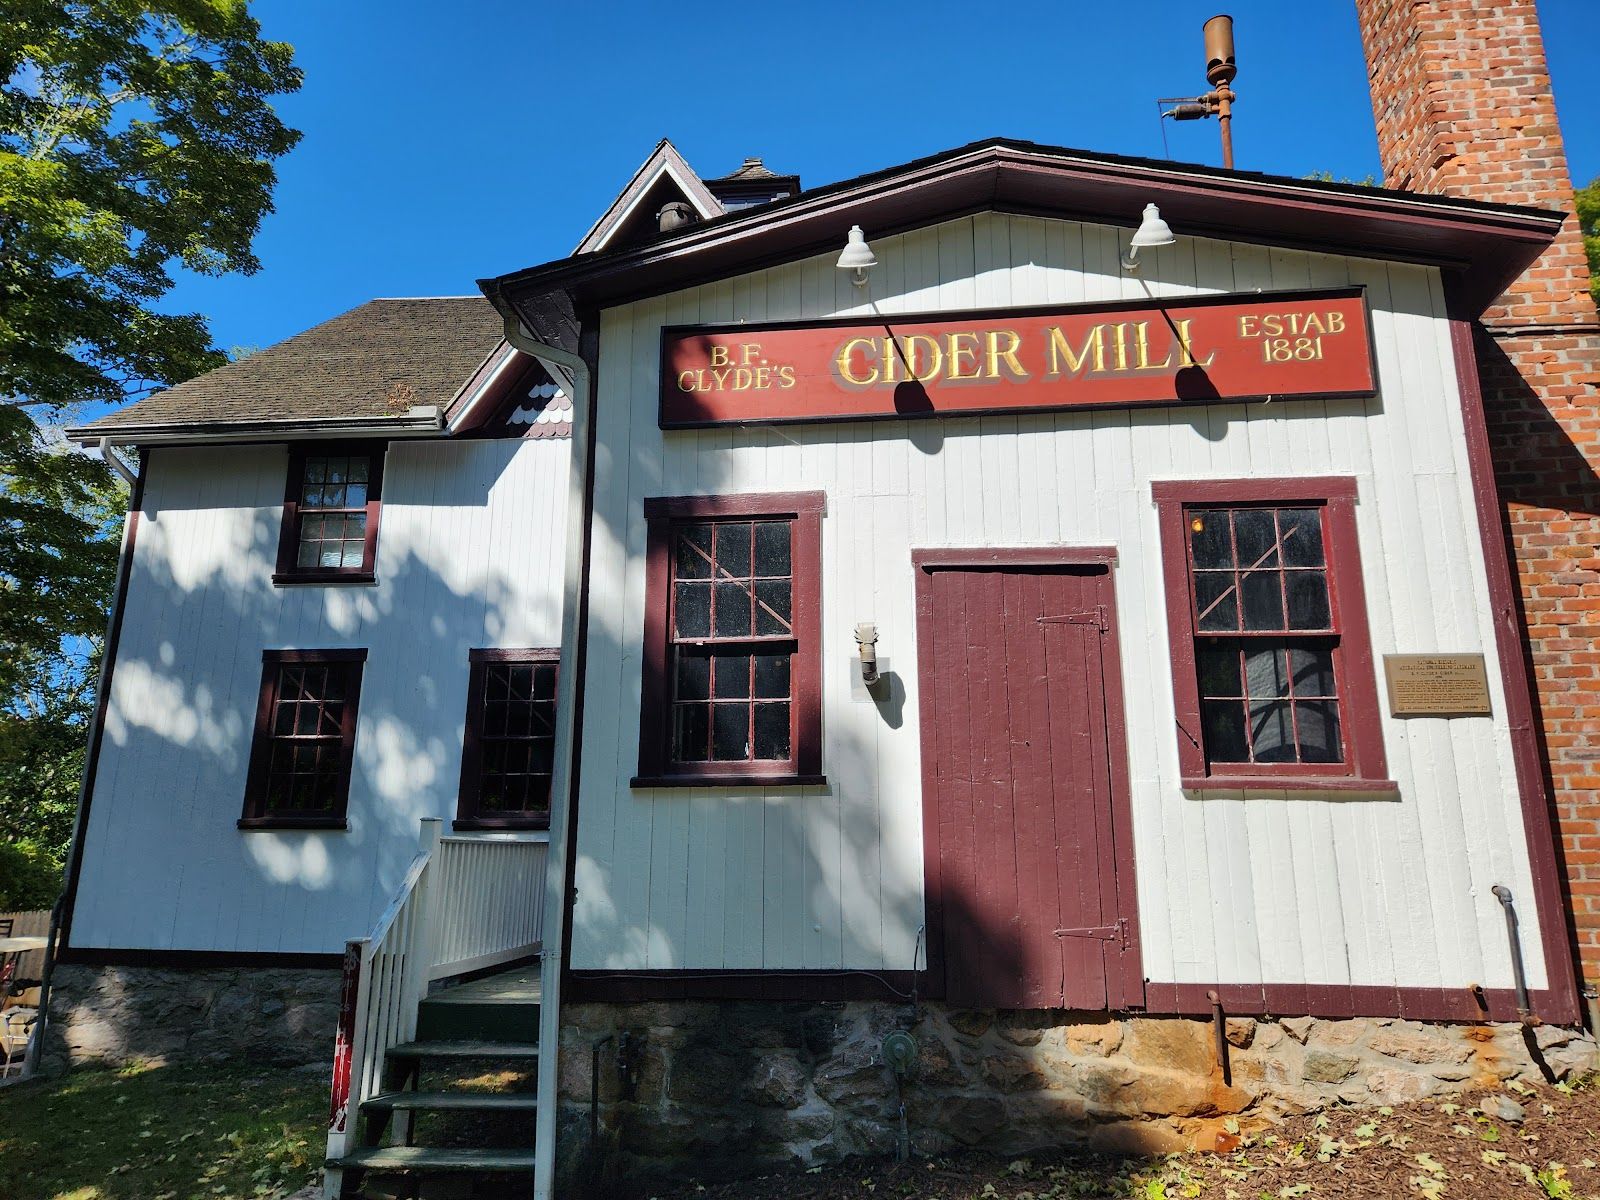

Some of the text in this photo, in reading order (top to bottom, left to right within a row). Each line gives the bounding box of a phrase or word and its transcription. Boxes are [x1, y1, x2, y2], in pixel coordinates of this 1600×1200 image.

[1239, 311, 1346, 338] ESTAB
[836, 318, 1215, 386] CIDER MILL
[1263, 337, 1323, 362] 1881
[678, 366, 796, 393] CLYDE'S
